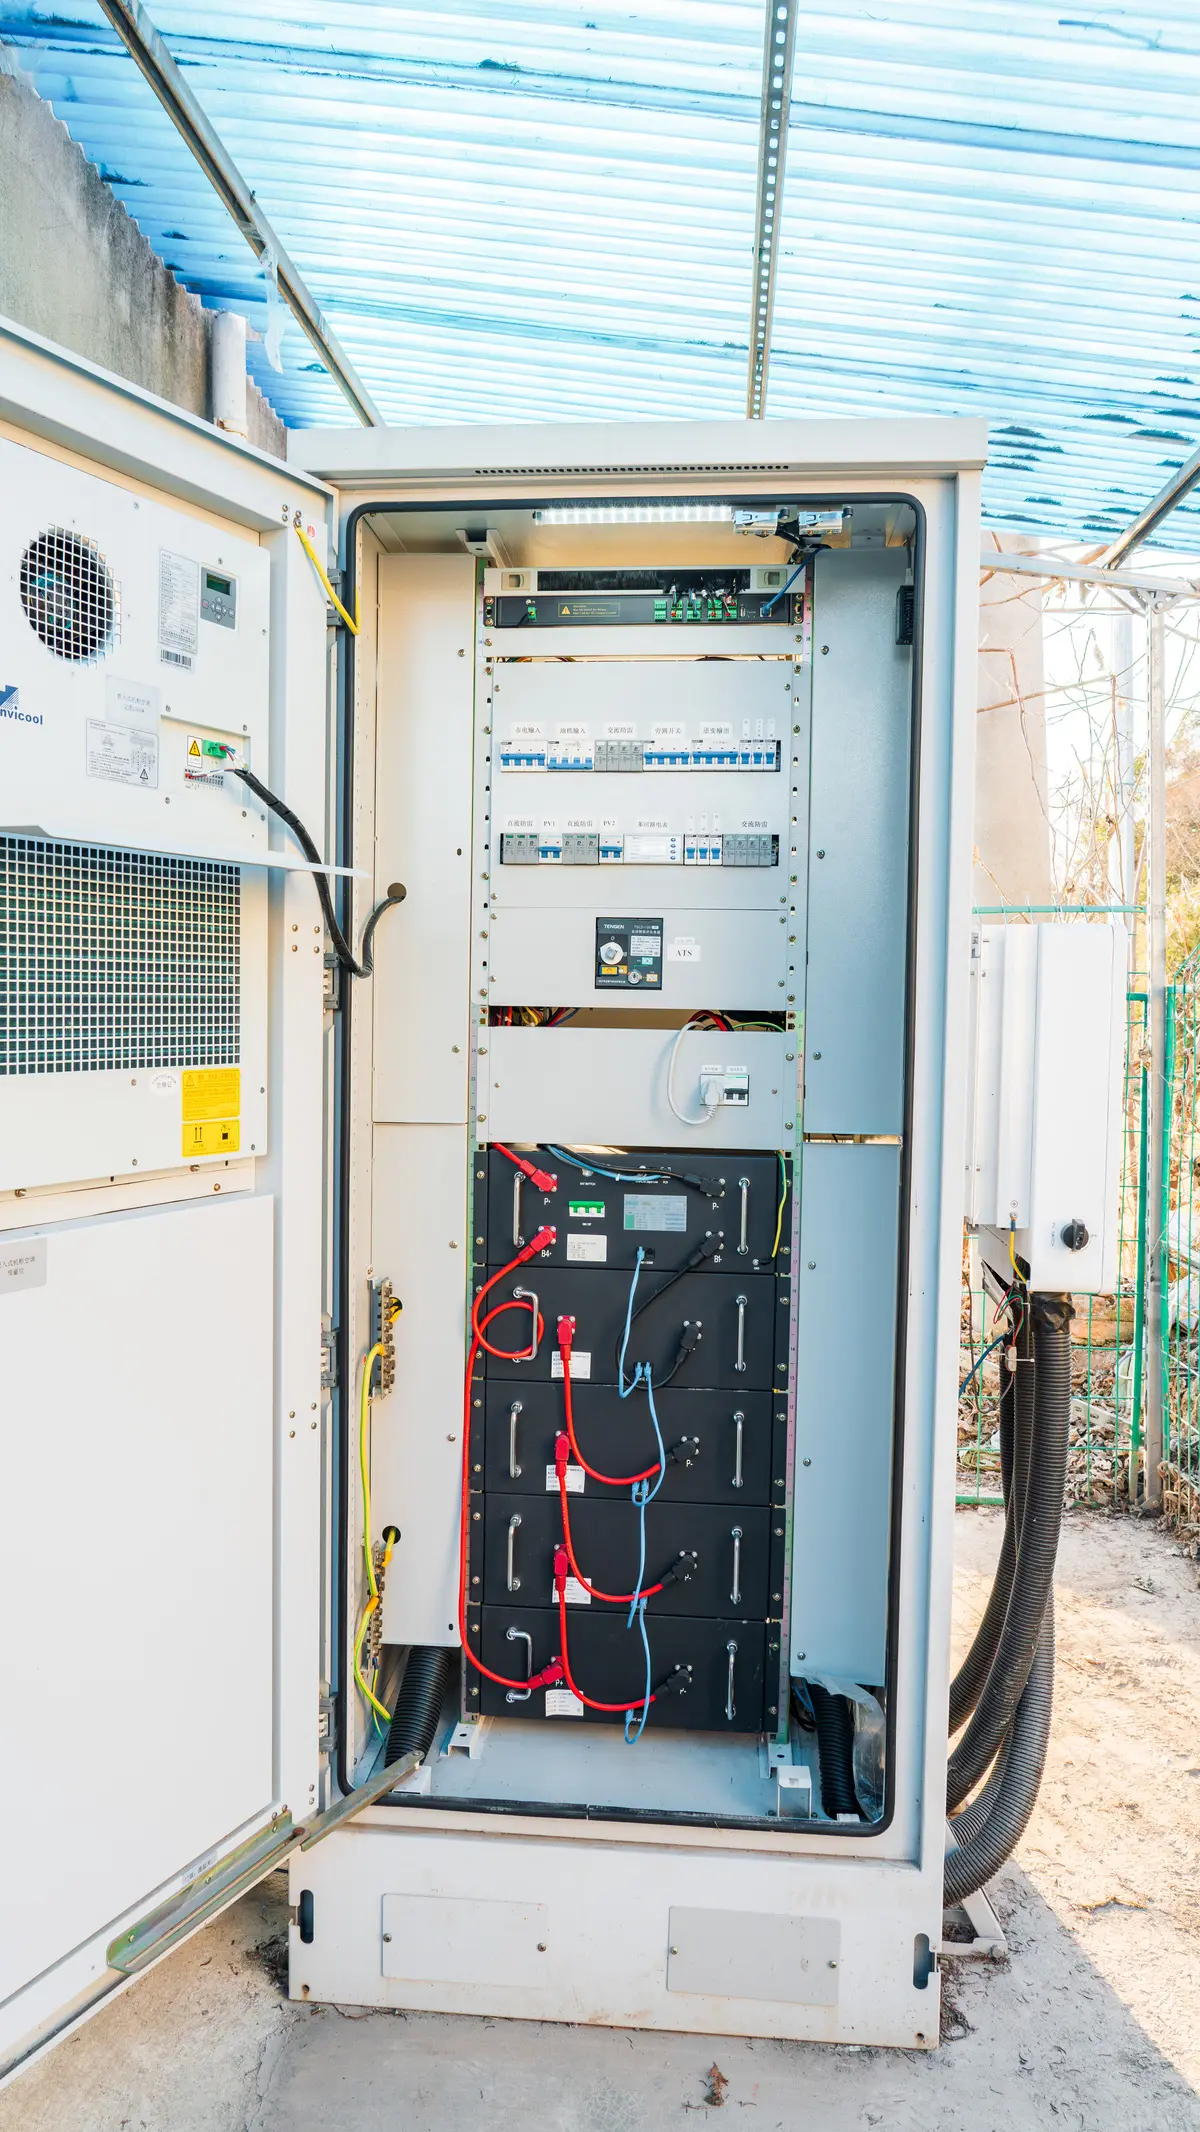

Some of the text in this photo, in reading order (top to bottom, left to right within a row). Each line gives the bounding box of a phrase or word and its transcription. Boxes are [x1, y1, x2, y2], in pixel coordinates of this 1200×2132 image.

[655, 727, 682, 735] 旁路开关
[703, 727, 730, 735] 逆变输出
[741, 820, 769, 828] 交流防雷
[675, 949, 693, 957] ATS
